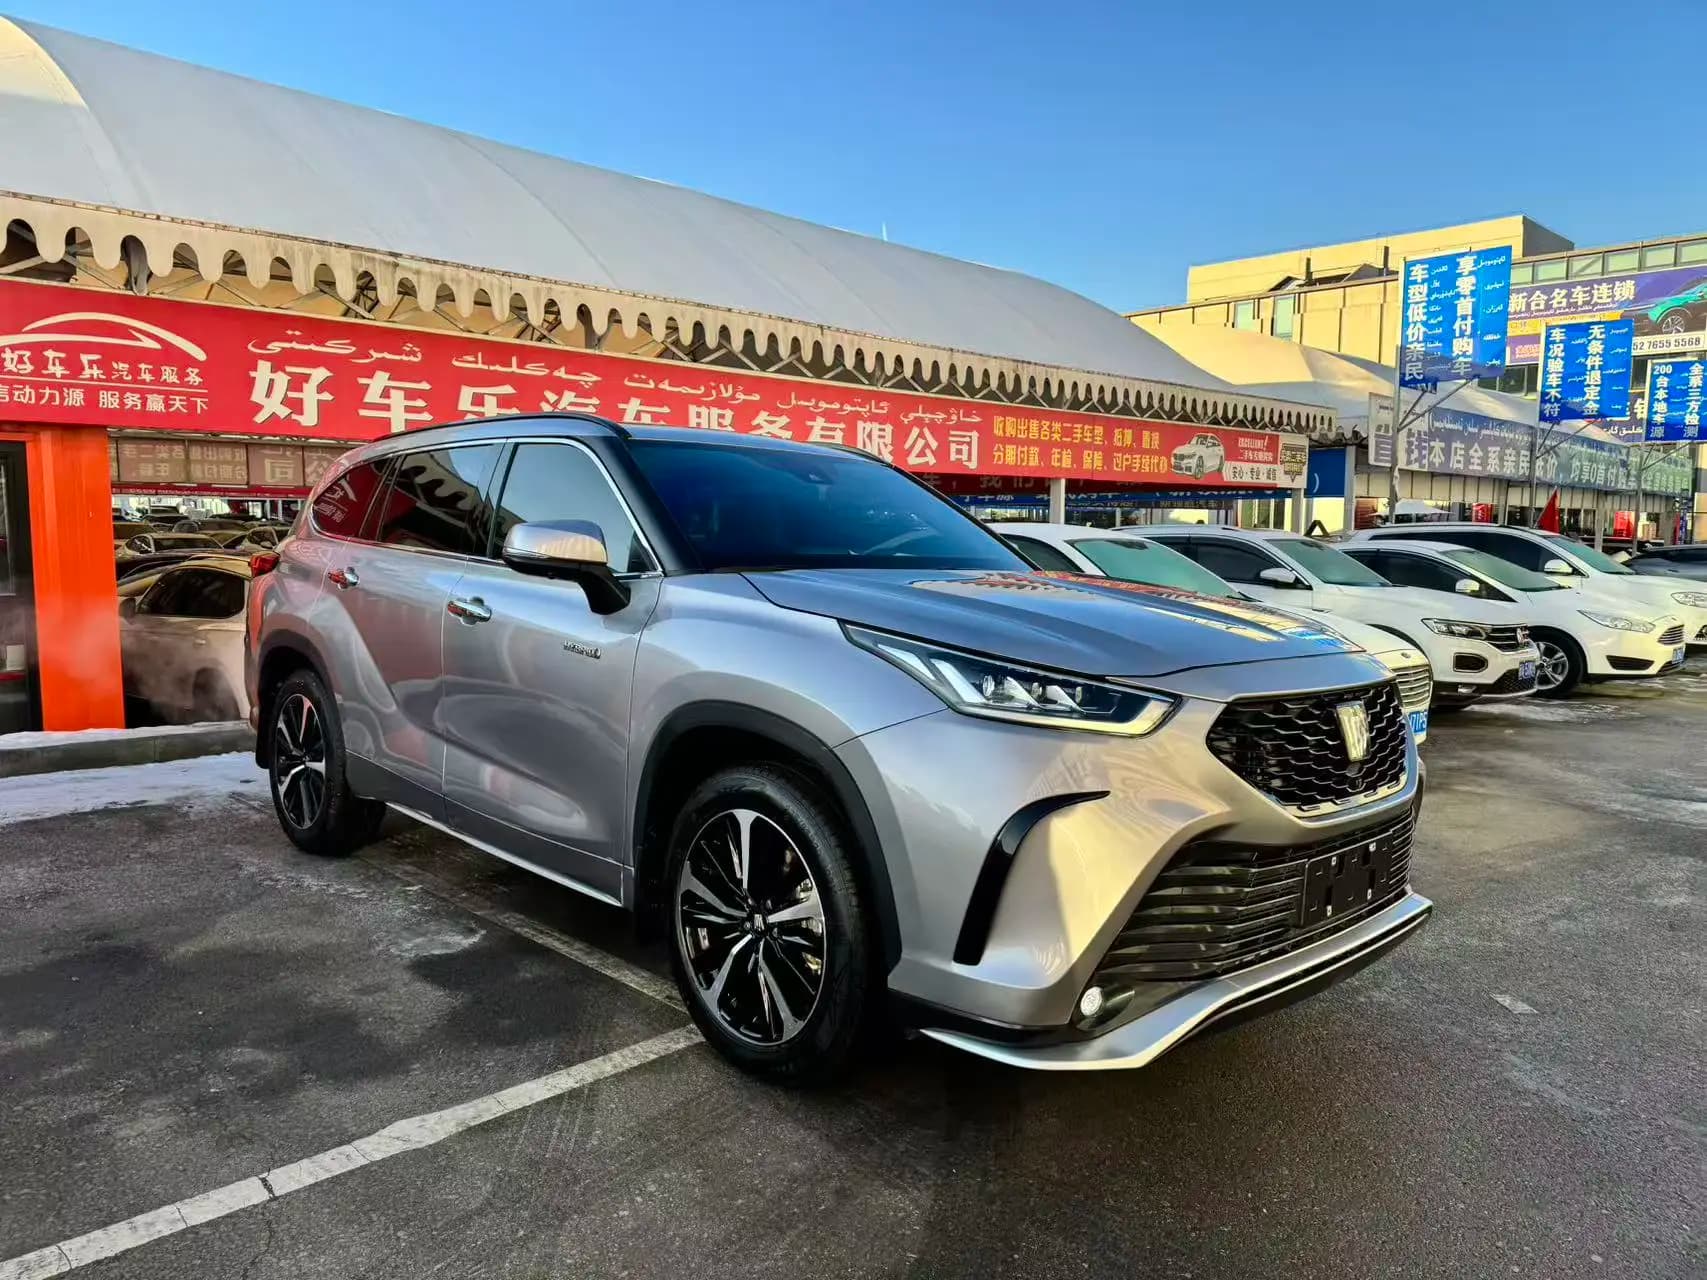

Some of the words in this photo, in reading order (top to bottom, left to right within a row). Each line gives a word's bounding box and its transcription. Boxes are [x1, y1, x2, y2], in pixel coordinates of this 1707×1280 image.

[1405, 263, 1430, 381] 车型低价亲民
[1451, 256, 1477, 376] 享零首付购车
[111, 360, 204, 386] 汽车服务
[1582, 324, 1607, 416] 无条件退定金
[1653, 364, 1673, 375] 200
[99, 390, 209, 415] 服务赢天下
